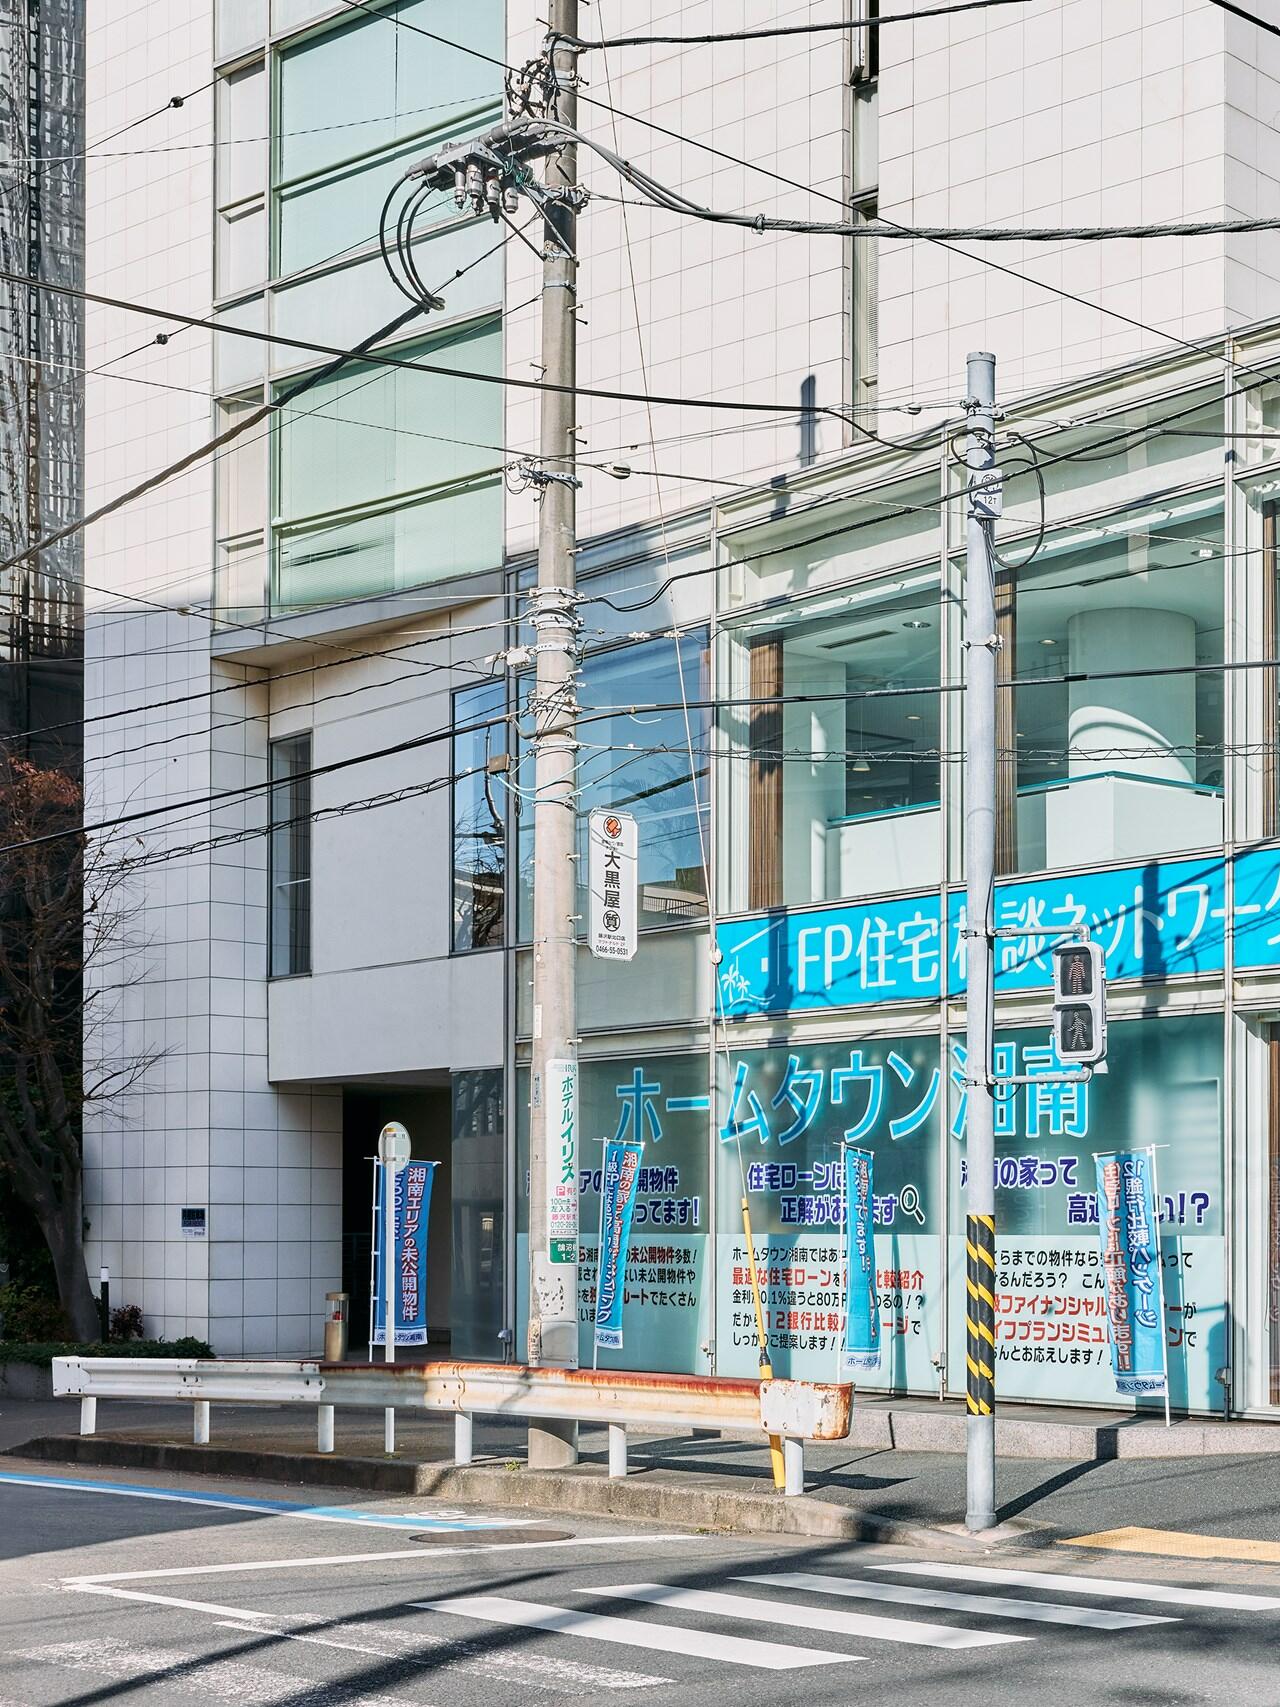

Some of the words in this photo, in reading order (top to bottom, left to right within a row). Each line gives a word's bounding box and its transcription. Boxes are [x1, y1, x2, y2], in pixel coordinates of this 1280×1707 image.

[604, 851, 621, 909] 大黒屋
[604, 911, 619, 931] 質
[614, 1040, 1089, 1146] ホームタウン湘南
[561, 1076, 575, 1184] ホテルイリス
[961, 1157, 1079, 1189] の家って
[631, 1196, 700, 1226] ってます!
[402, 1167, 427, 1321] 湘南エリアの未公開物件
